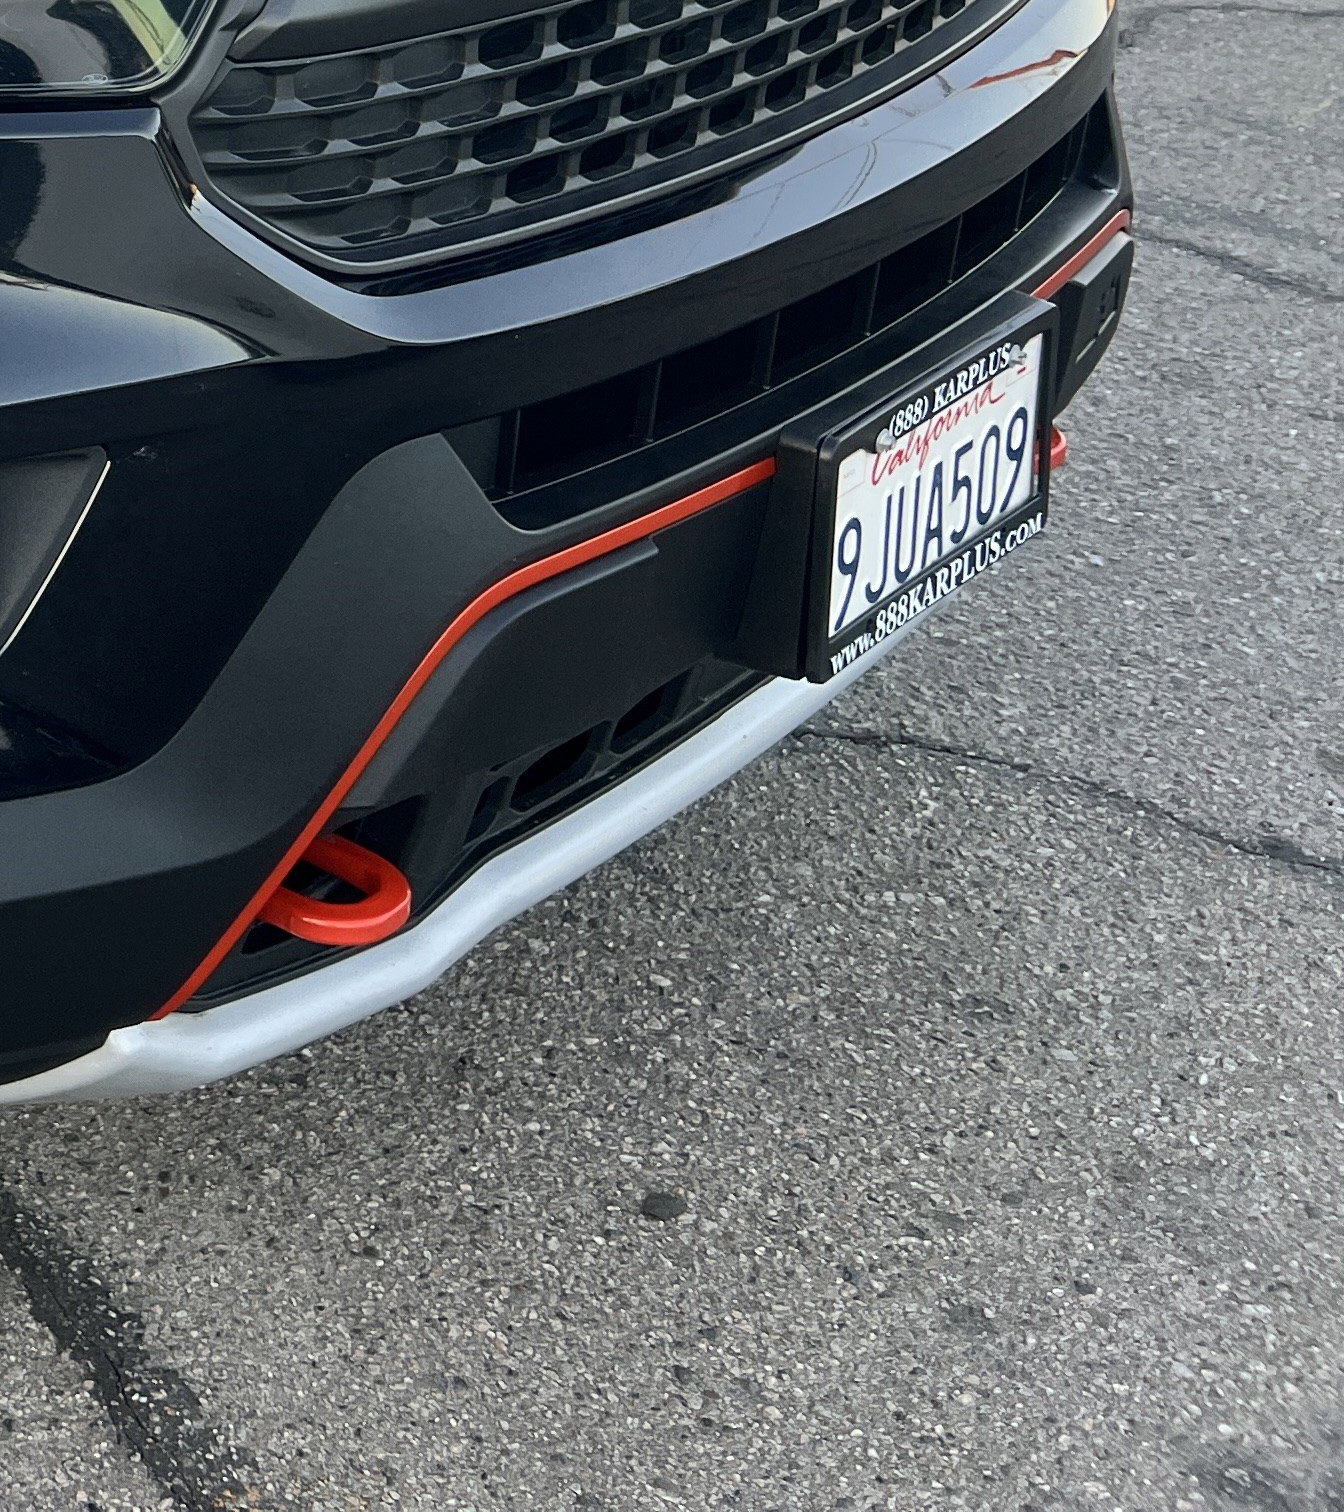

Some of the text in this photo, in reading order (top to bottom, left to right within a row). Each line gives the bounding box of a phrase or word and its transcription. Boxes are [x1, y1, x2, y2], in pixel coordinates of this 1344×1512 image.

[889, 342, 1012, 437] (888) KARPLUS
[833, 406, 1028, 632] 9JUA509
